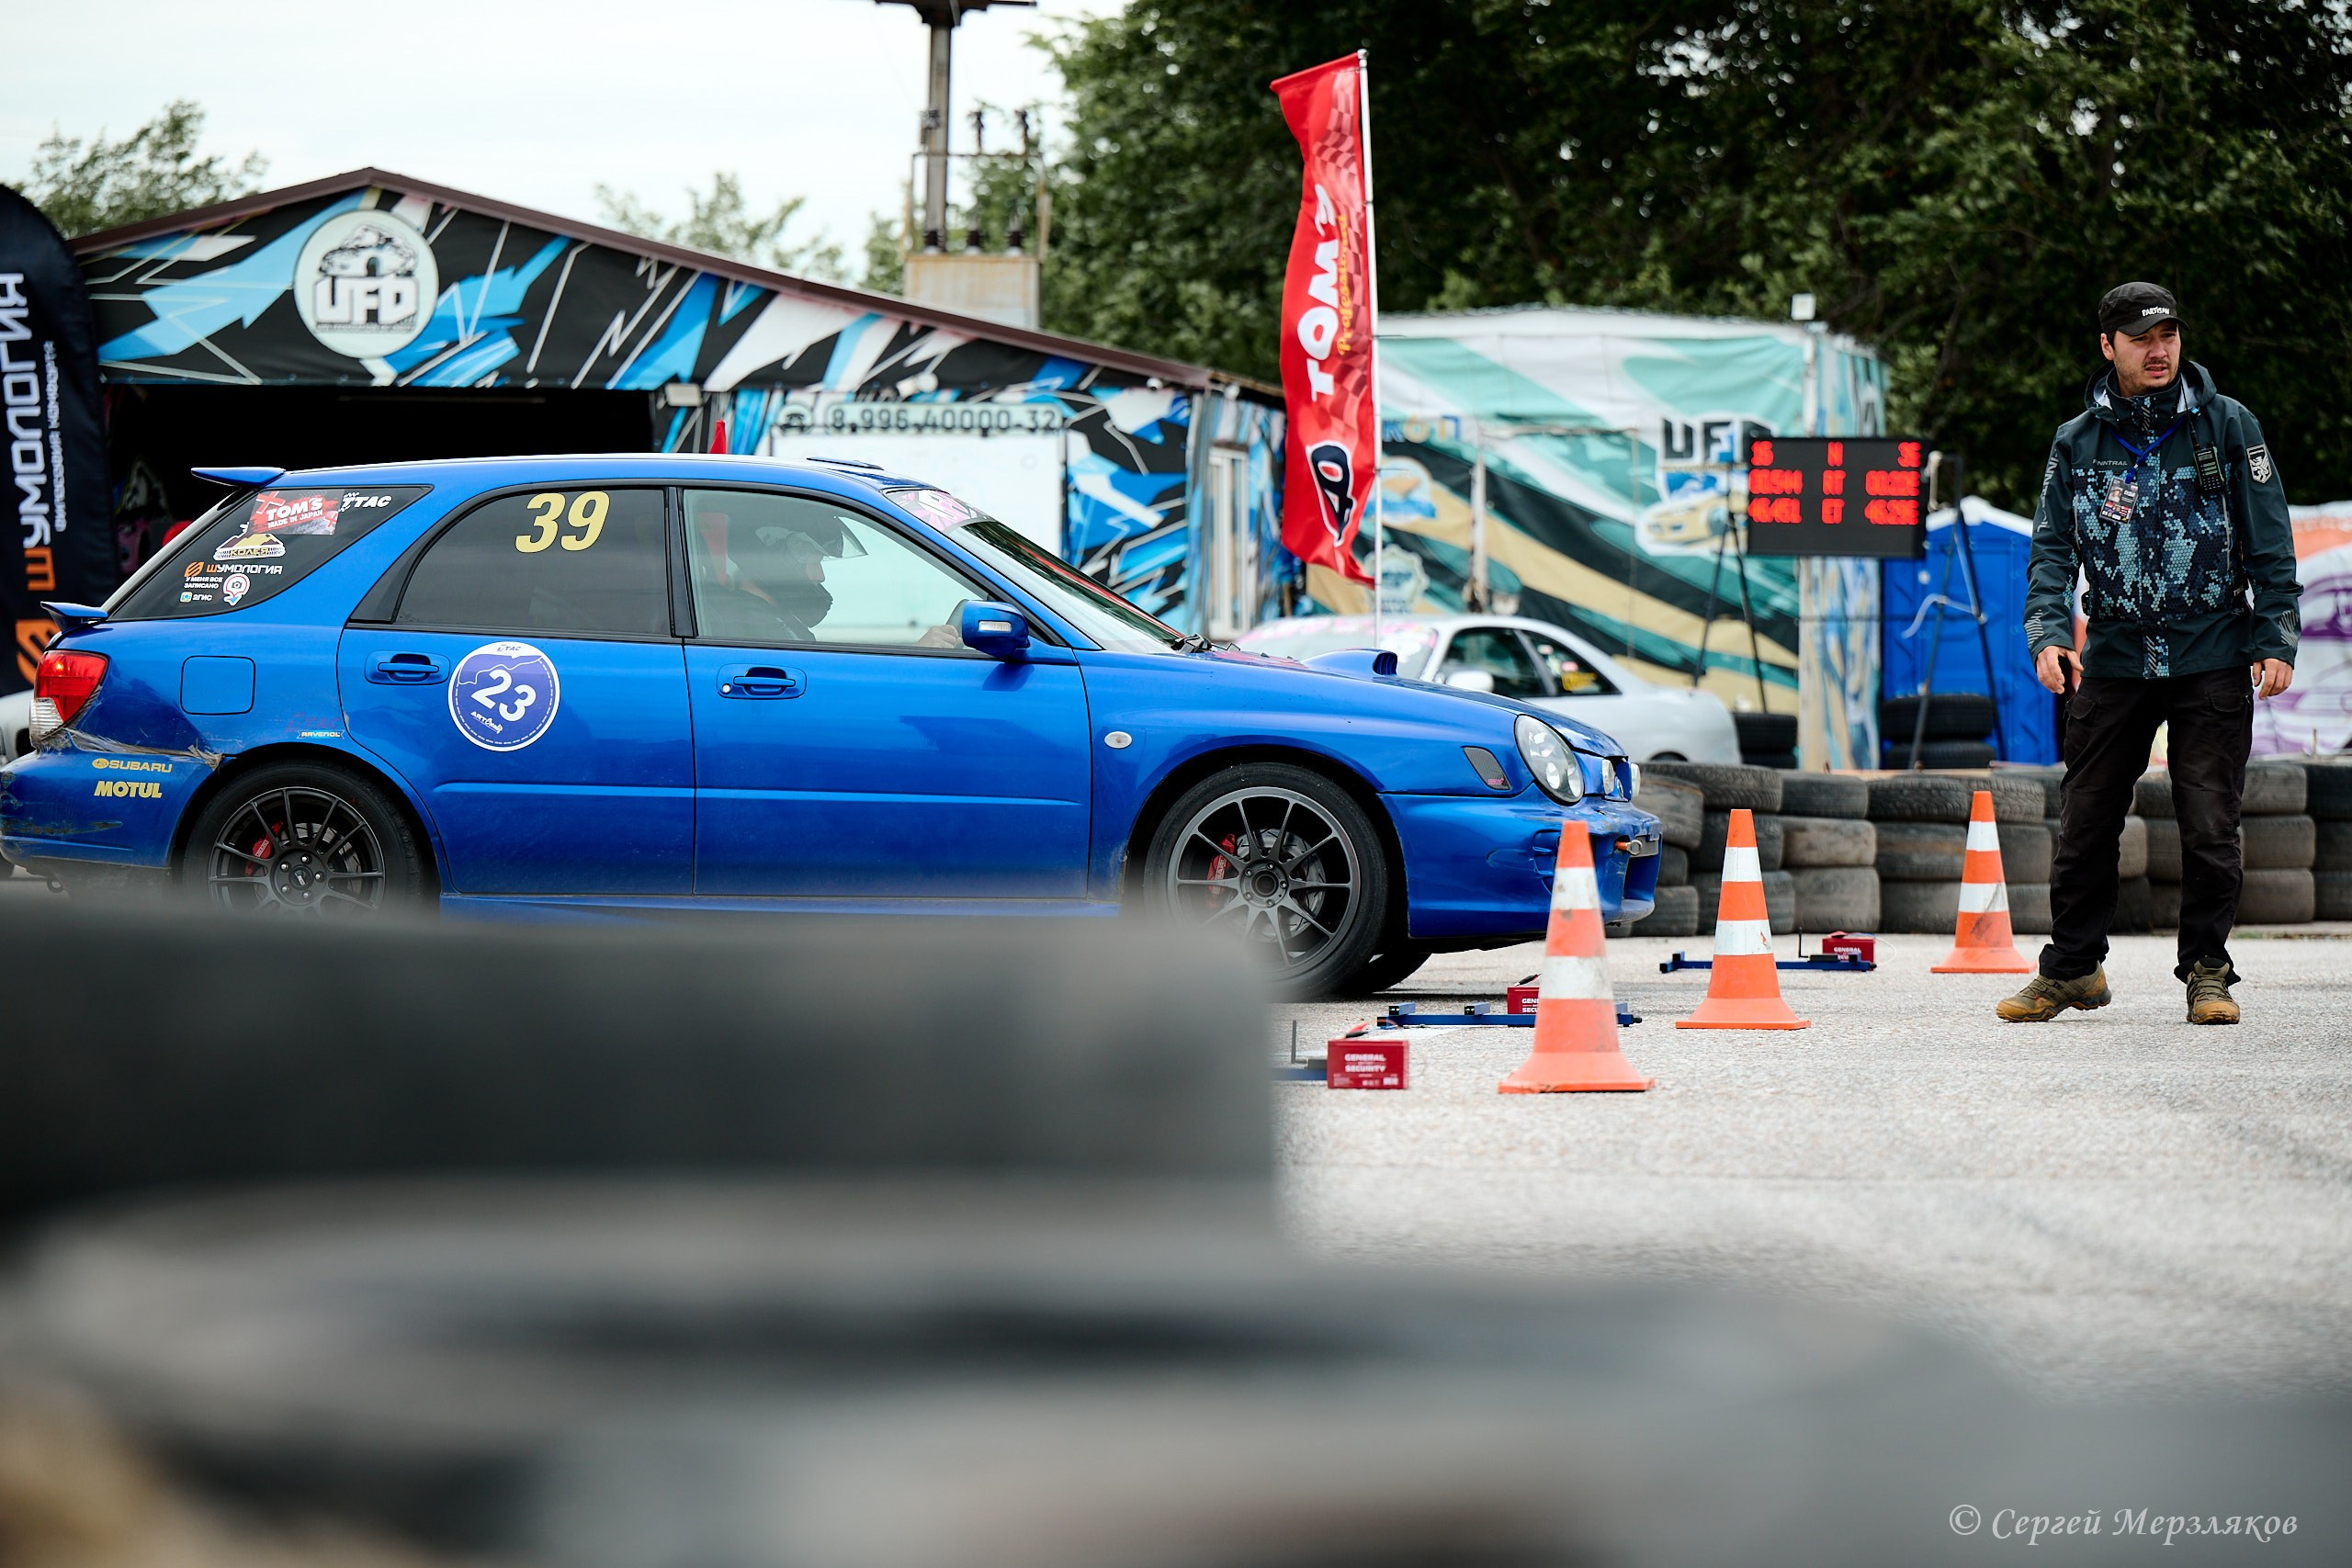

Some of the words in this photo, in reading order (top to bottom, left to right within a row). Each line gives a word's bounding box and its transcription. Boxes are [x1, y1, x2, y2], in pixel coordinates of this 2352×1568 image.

[0, 272, 56, 592] ШУМОЛОГИЯ
[266, 497, 323, 522] TOM'S
[267, 518, 288, 528] MADE
[300, 510, 322, 521] JAPAN
[515, 491, 610, 553] 39
[206, 564, 283, 575] ШУМОЛОГИЯ
[470, 669, 537, 722] 23
[108, 760, 173, 773] SUBARU
[94, 780, 163, 798] MOTUL
[1344, 1053, 1387, 1062] GENERAL
[1344, 1065, 1386, 1073] SECURITY
